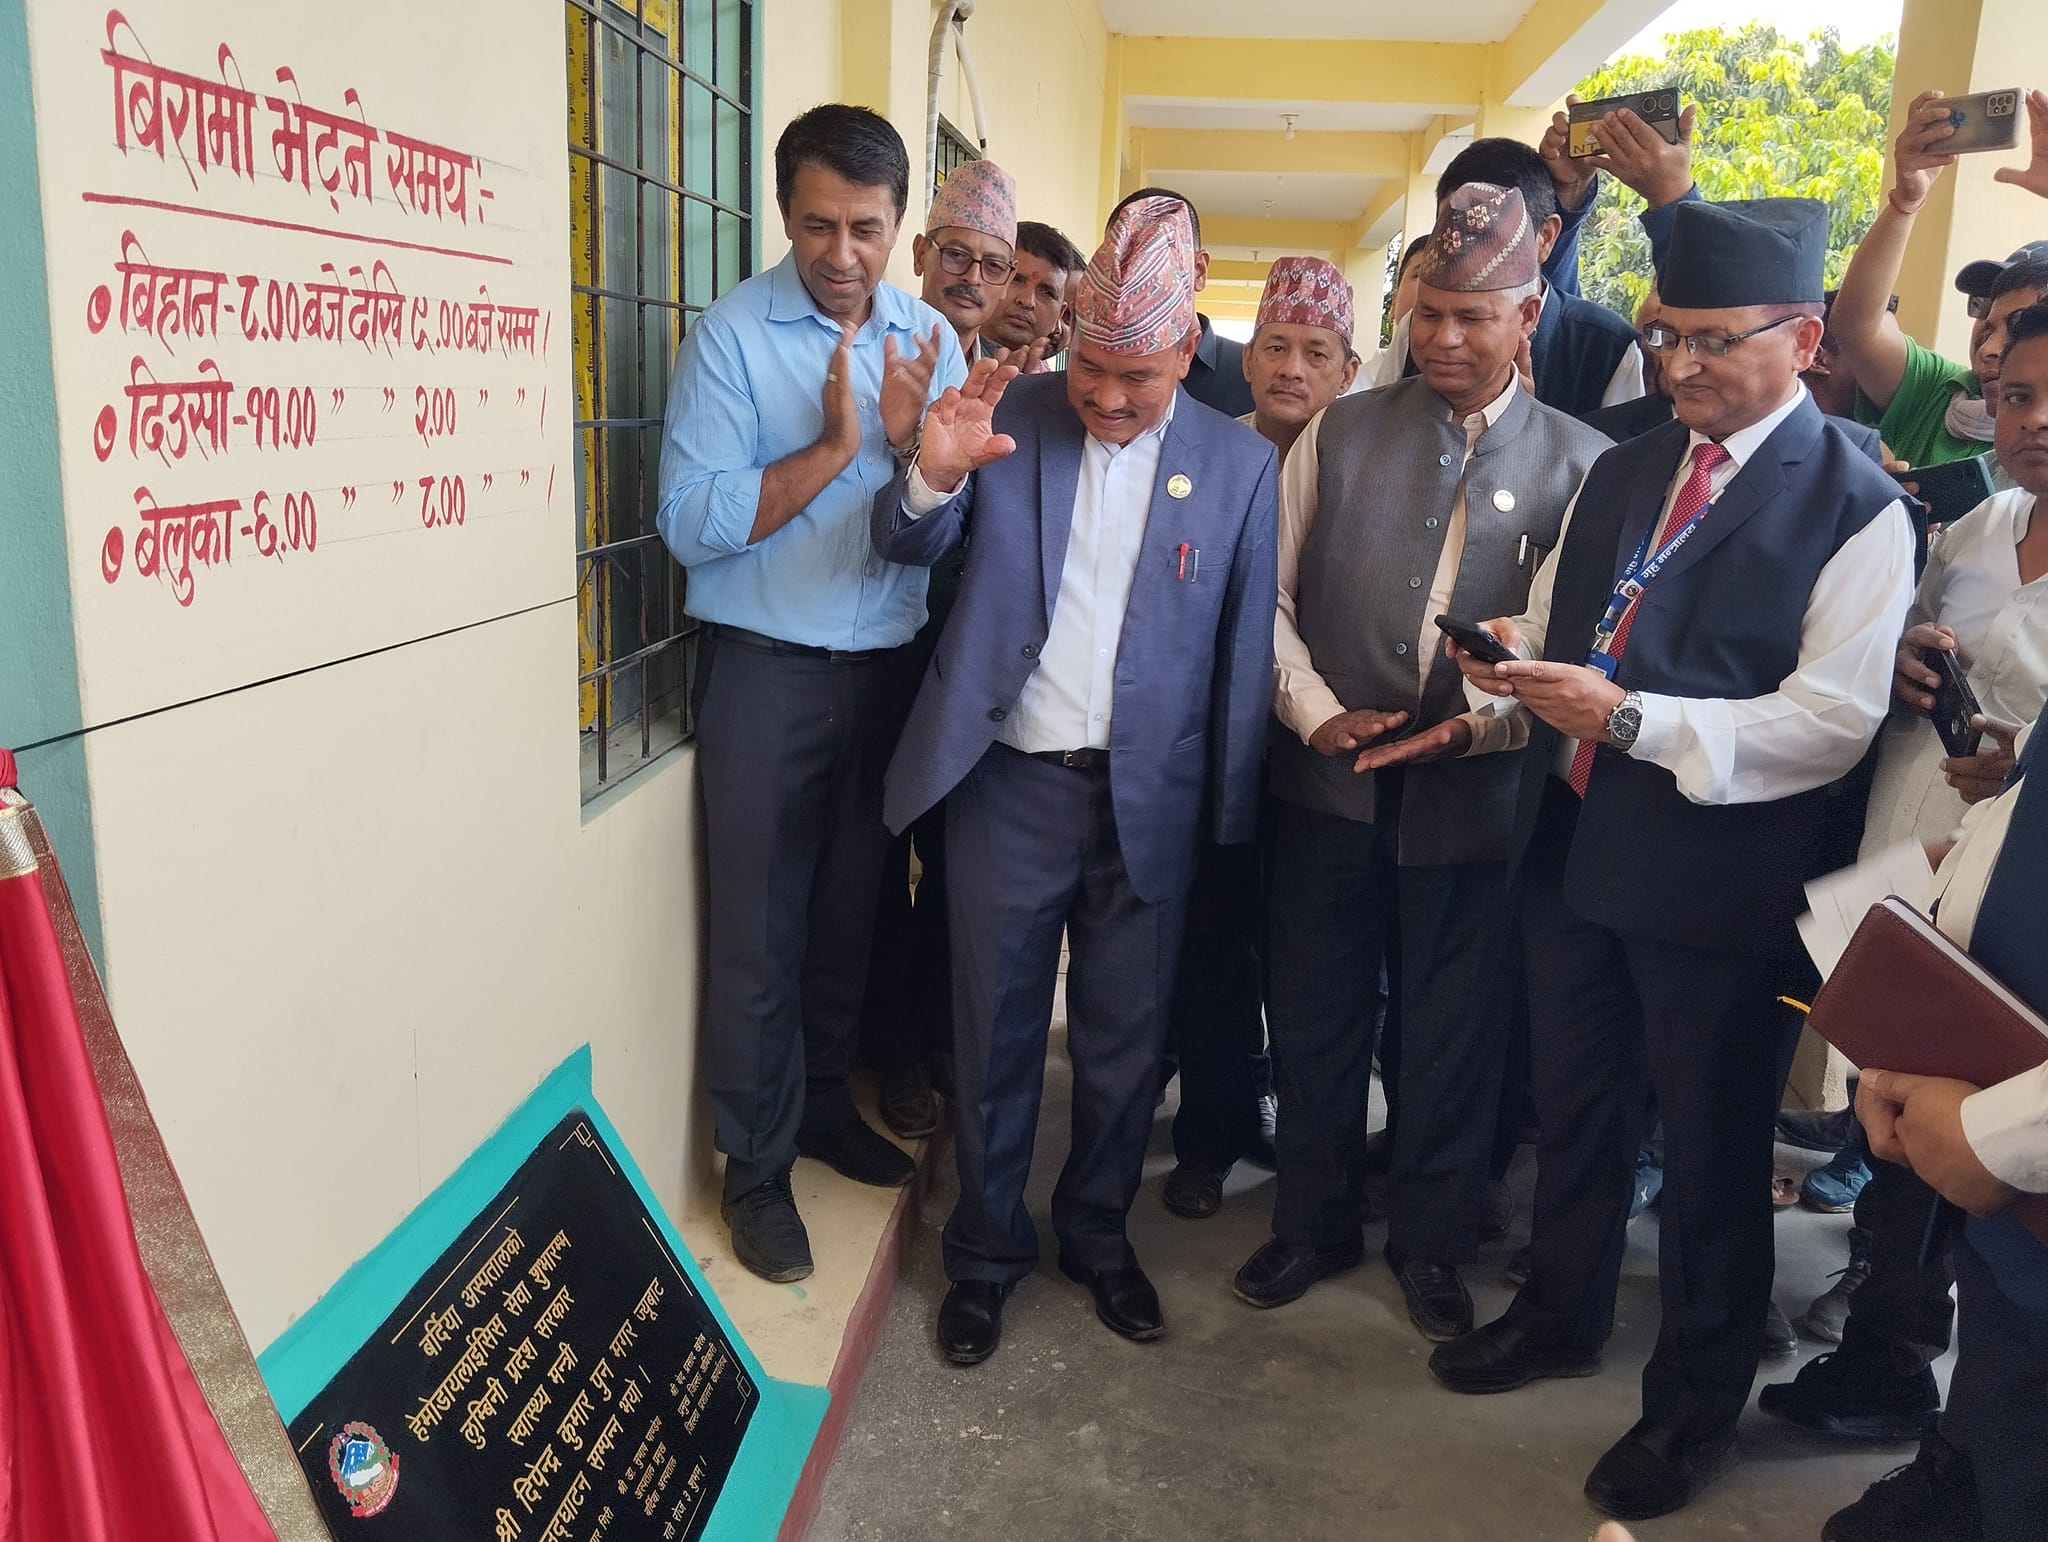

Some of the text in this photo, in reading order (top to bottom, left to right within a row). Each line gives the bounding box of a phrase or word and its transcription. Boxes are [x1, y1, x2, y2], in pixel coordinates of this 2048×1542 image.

[101, 9, 258, 191] बिरामी
[265, 66, 380, 213] भेट्ने
[1641, 523, 1697, 580] गृह मन्त्रालय
[404, 1229, 572, 1442] हेमोडायलाईसिस सेवा शुभारम्भ
[418, 1226, 526, 1357] बर्दिया अस्पतालको
[459, 1284, 575, 1450] लुम्बिनी प्रदेश सरकार
[495, 1276, 665, 1542] श्री दिपेन्द्र कुमार पुन मगर ज्यूबाट
[506, 1341, 579, 1447] स्वास्थ्य मन्त्री
[586, 1413, 624, 1471] सम्पन्न
[618, 1377, 644, 1414] भयो
[597, 1505, 614, 1531] गिरी
